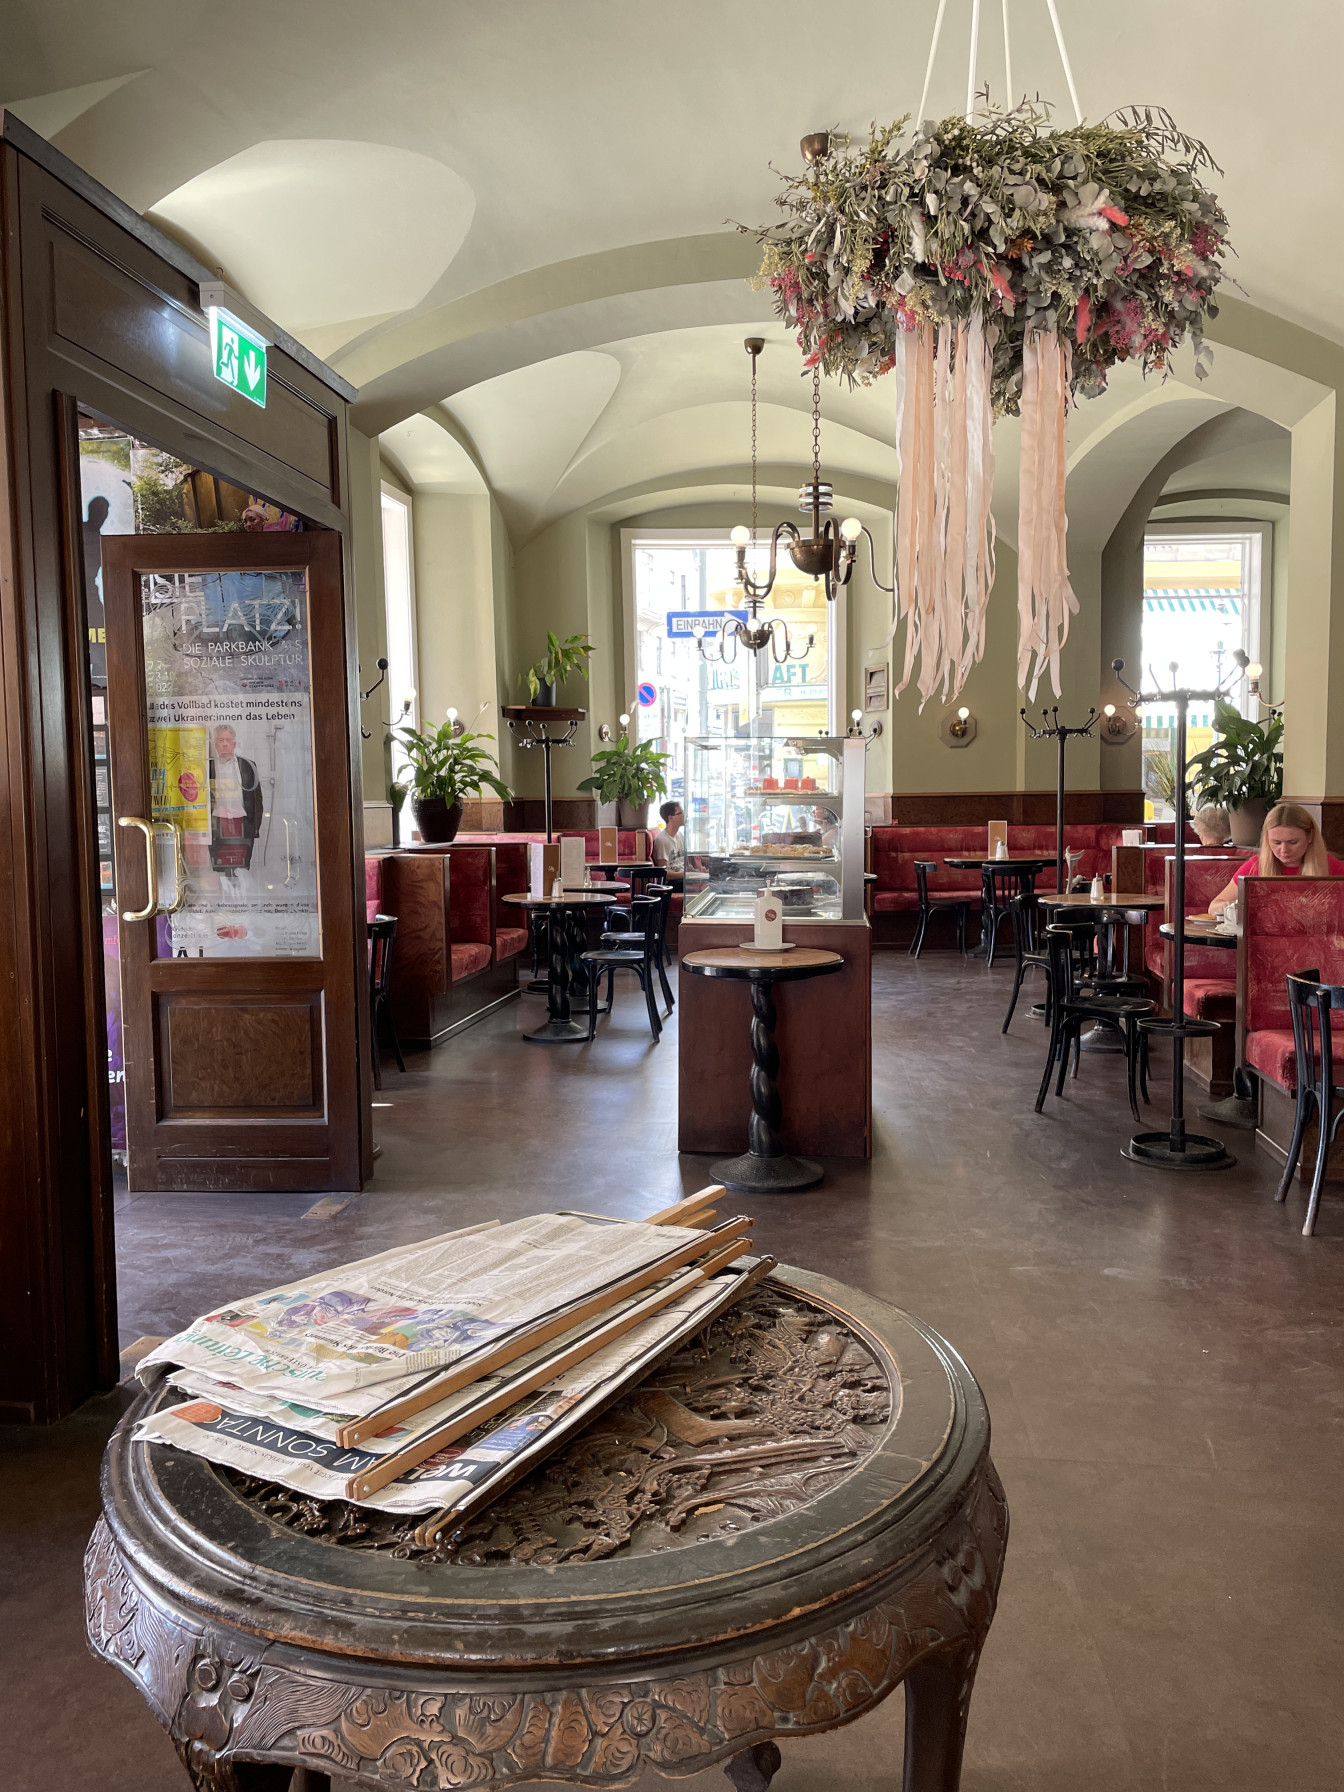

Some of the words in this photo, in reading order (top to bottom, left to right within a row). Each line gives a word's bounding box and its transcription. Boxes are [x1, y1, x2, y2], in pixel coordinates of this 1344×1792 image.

[181, 598, 301, 633] PLATZ!
[182, 643, 202, 654] DIE
[208, 640, 274, 653] PARKBANK
[183, 656, 233, 669] SOZIALE
[240, 654, 304, 667] SKULPTUR
[177, 699, 212, 710] Vollbad
[213, 699, 244, 709] kostet
[246, 698, 302, 709] mindestens
[174, 713, 243, 723] Ukrainer:innen
[245, 711, 263, 721] das
[266, 710, 295, 721] Leben
